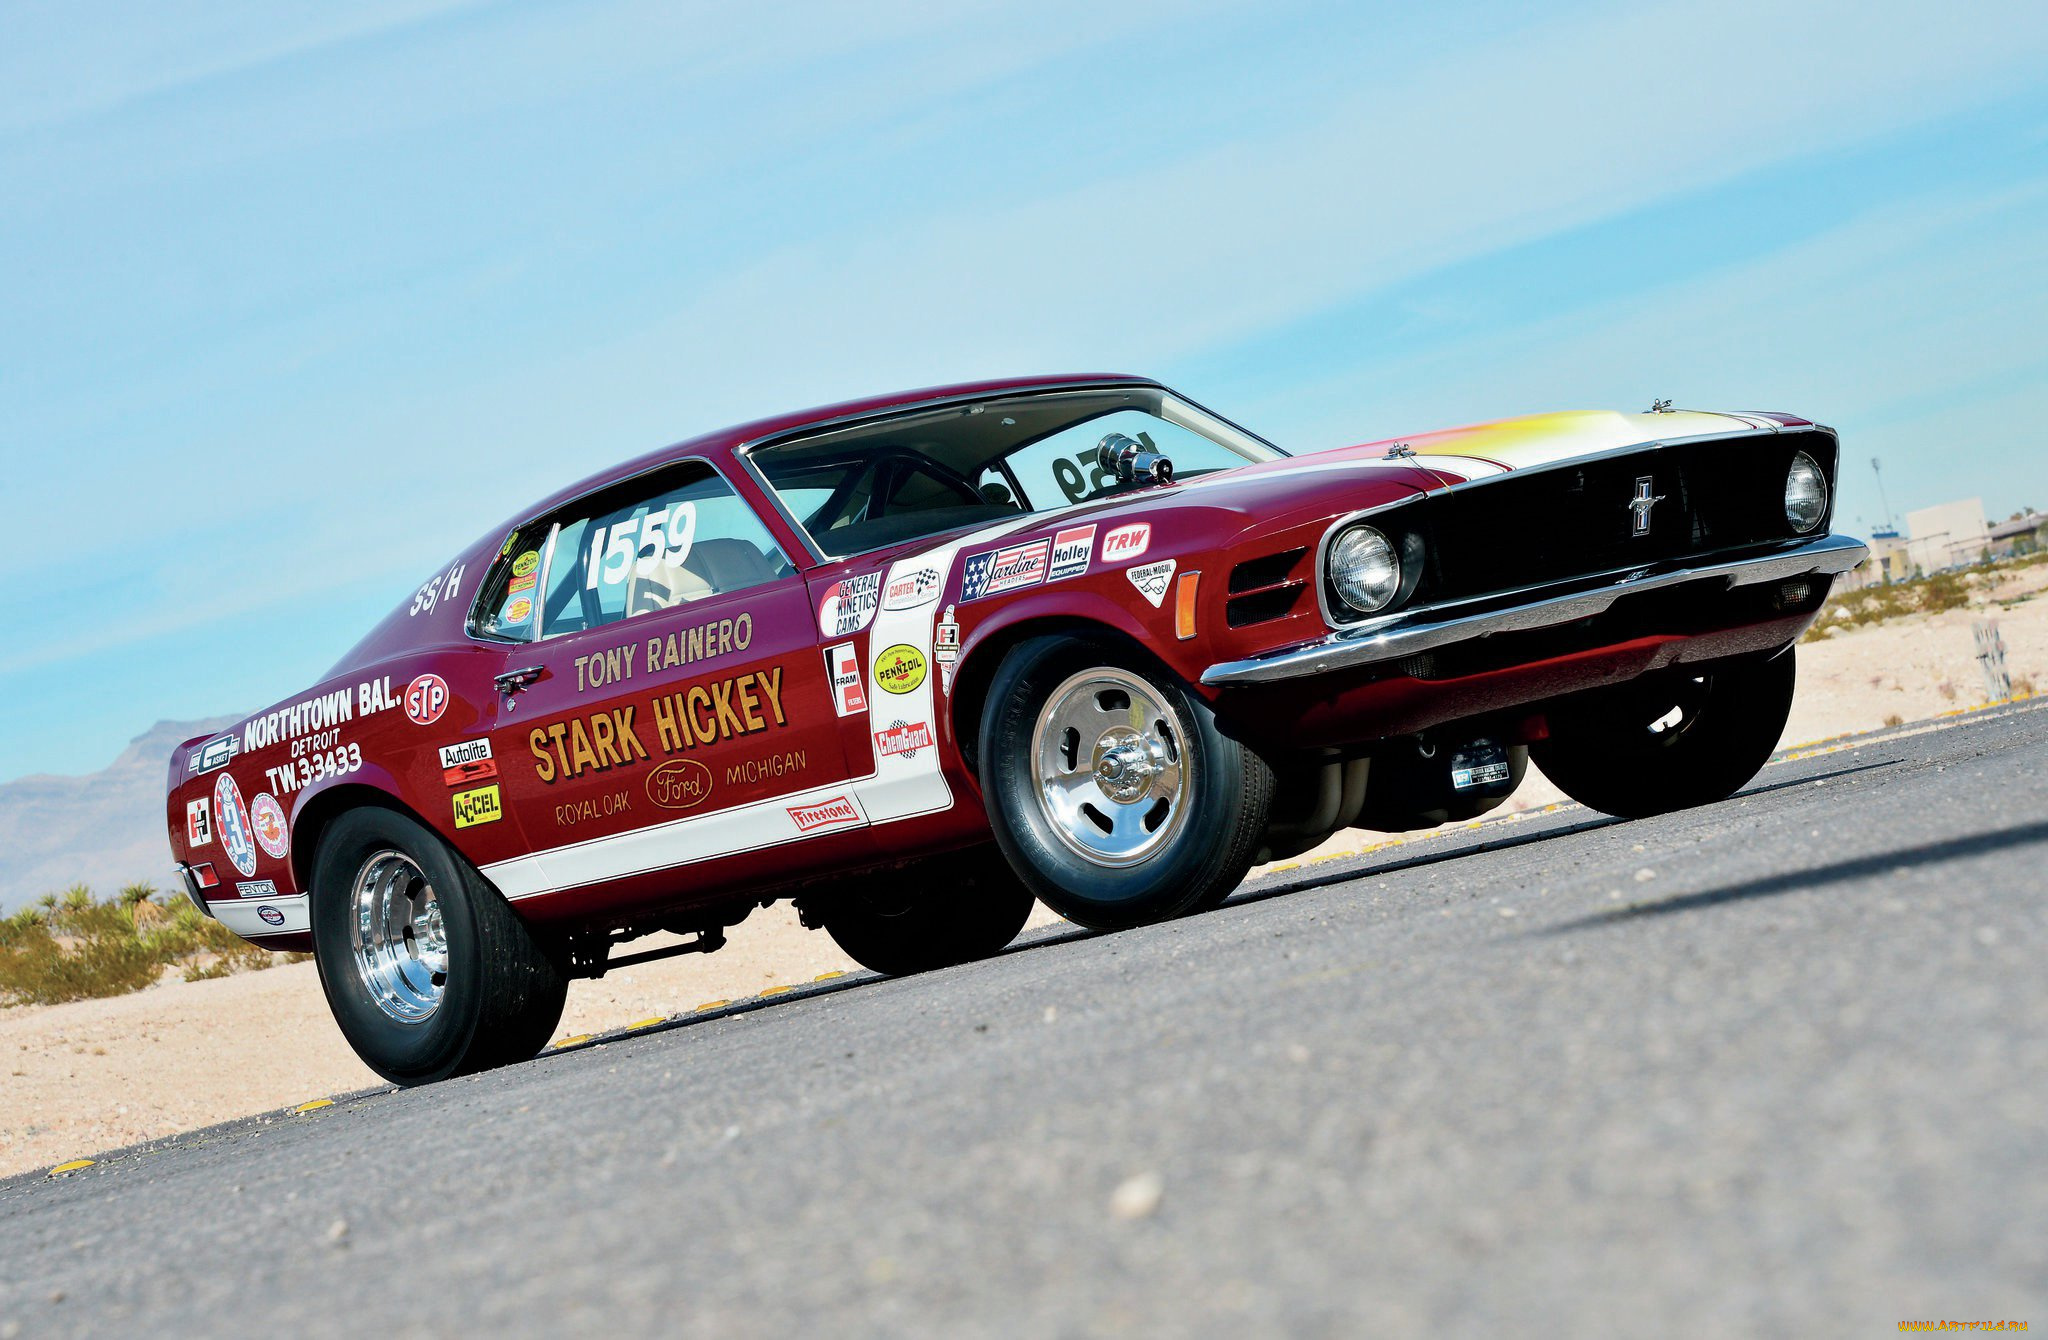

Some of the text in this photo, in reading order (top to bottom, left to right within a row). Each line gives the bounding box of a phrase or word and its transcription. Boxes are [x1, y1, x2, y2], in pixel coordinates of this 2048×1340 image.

[586, 501, 697, 591] 1559
[1106, 530, 1147, 552] TRW
[1054, 546, 1090, 564] Holley
[979, 551, 1039, 597] Jardine
[999, 575, 1026, 586] HEADERS
[1052, 565, 1086, 577] EQUIPPED
[1131, 563, 1172, 579] FEDERAL-MOGUL
[410, 560, 466, 616] SS/H
[839, 573, 878, 598] GENERAL
[889, 581, 914, 598] CARTER
[837, 590, 878, 617] KINETICS
[836, 614, 861, 635] CAMS
[574, 612, 753, 692] TONY RAINERO
[836, 675, 857, 686] FRAM
[879, 657, 922, 682] PENNZOIL
[410, 679, 444, 718] STP
[244, 676, 402, 753] NORTHTOWN BAL.
[529, 667, 786, 784] STARK HICKEY
[291, 728, 340, 758] DETROIT
[446, 742, 487, 766] Autolite
[879, 727, 930, 756] ChemGuard
[726, 750, 806, 785] MICHIGAN
[656, 766, 703, 803] Ford
[455, 794, 499, 823] ACCEL
[555, 790, 632, 826] ROYAL OAK
[792, 804, 853, 828] Firestone
[240, 883, 275, 894] FENTON
